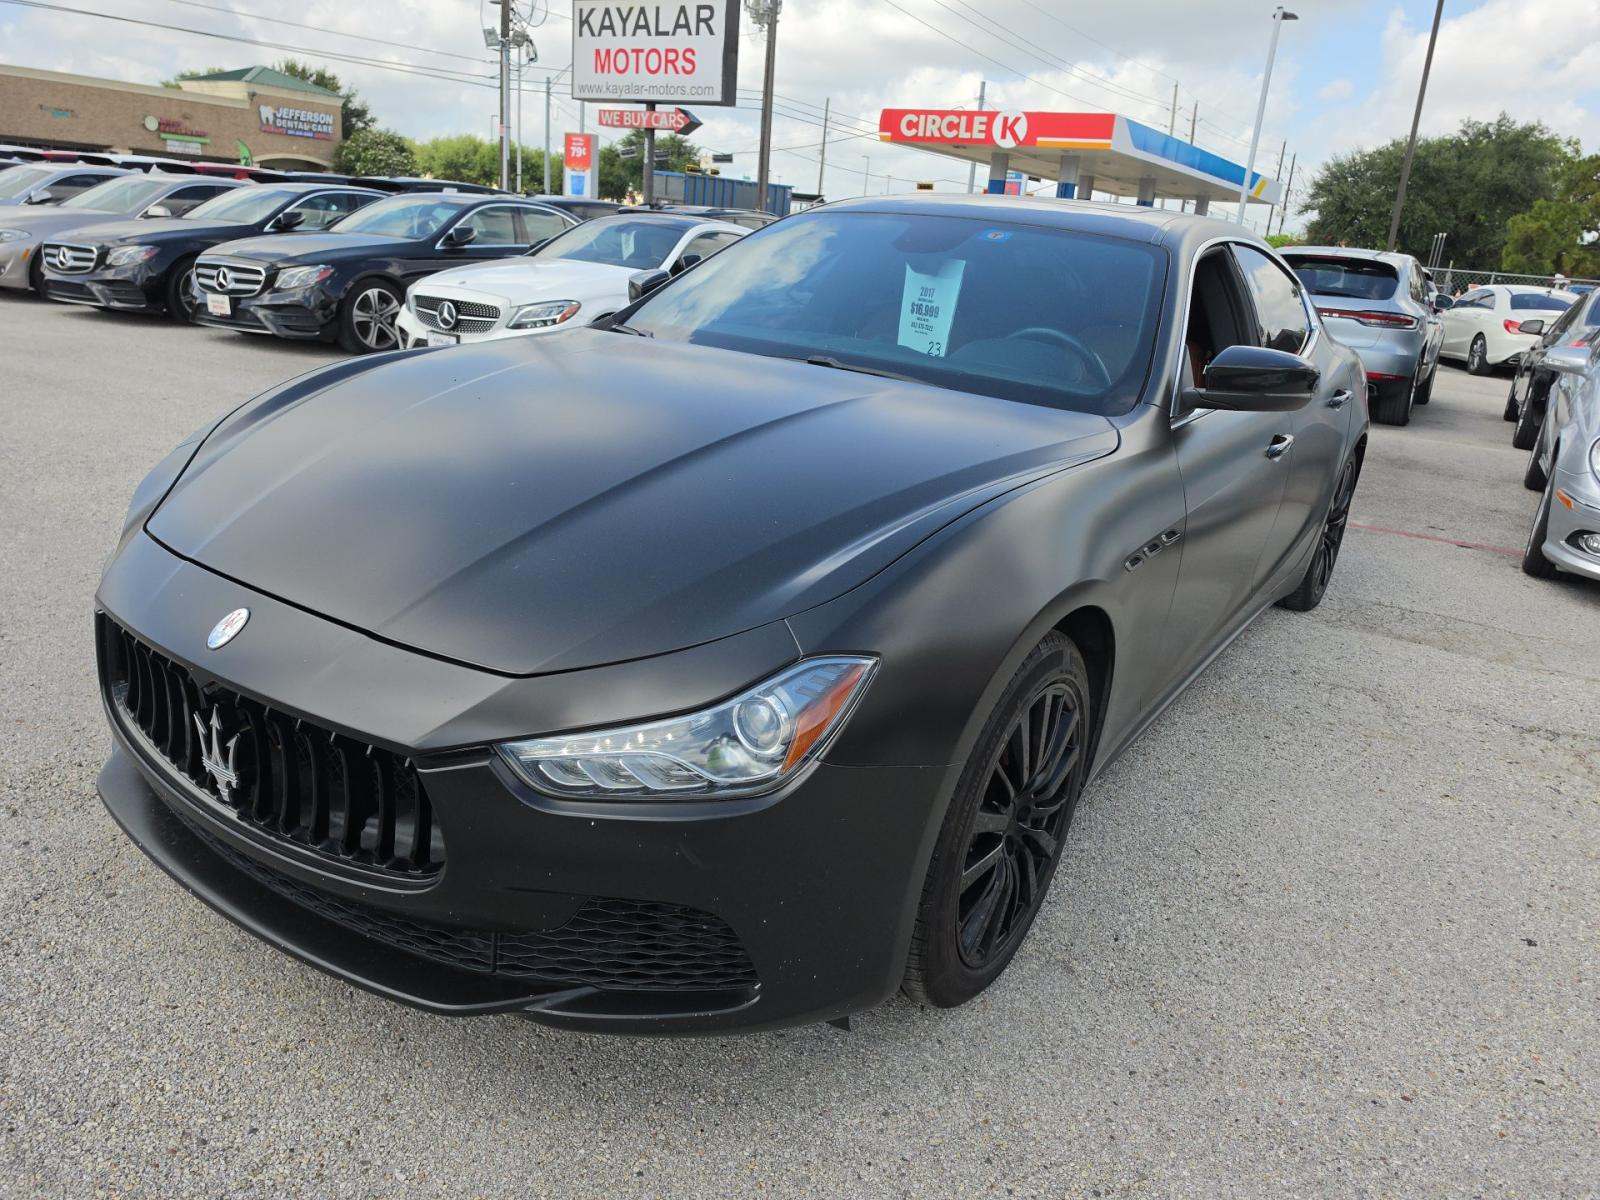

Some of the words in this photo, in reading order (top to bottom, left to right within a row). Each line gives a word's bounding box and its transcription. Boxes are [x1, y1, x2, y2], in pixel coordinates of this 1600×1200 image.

[578, 5, 715, 37] KAYALAR
[594, 48, 697, 75] MOTORS
[578, 82, 714, 97] www.kayalar-motors.com
[276, 107, 333, 124] JEFFERSON
[600, 111, 620, 126] WE
[623, 111, 648, 127] BUY
[651, 113, 686, 128] CARS
[276, 119, 309, 130] DENTAL
[311, 123, 334, 134] CARE
[900, 114, 987, 139] CIRCLE
[1001, 116, 1022, 144] K
[920, 287, 935, 298] 2017
[927, 341, 942, 357] 23
